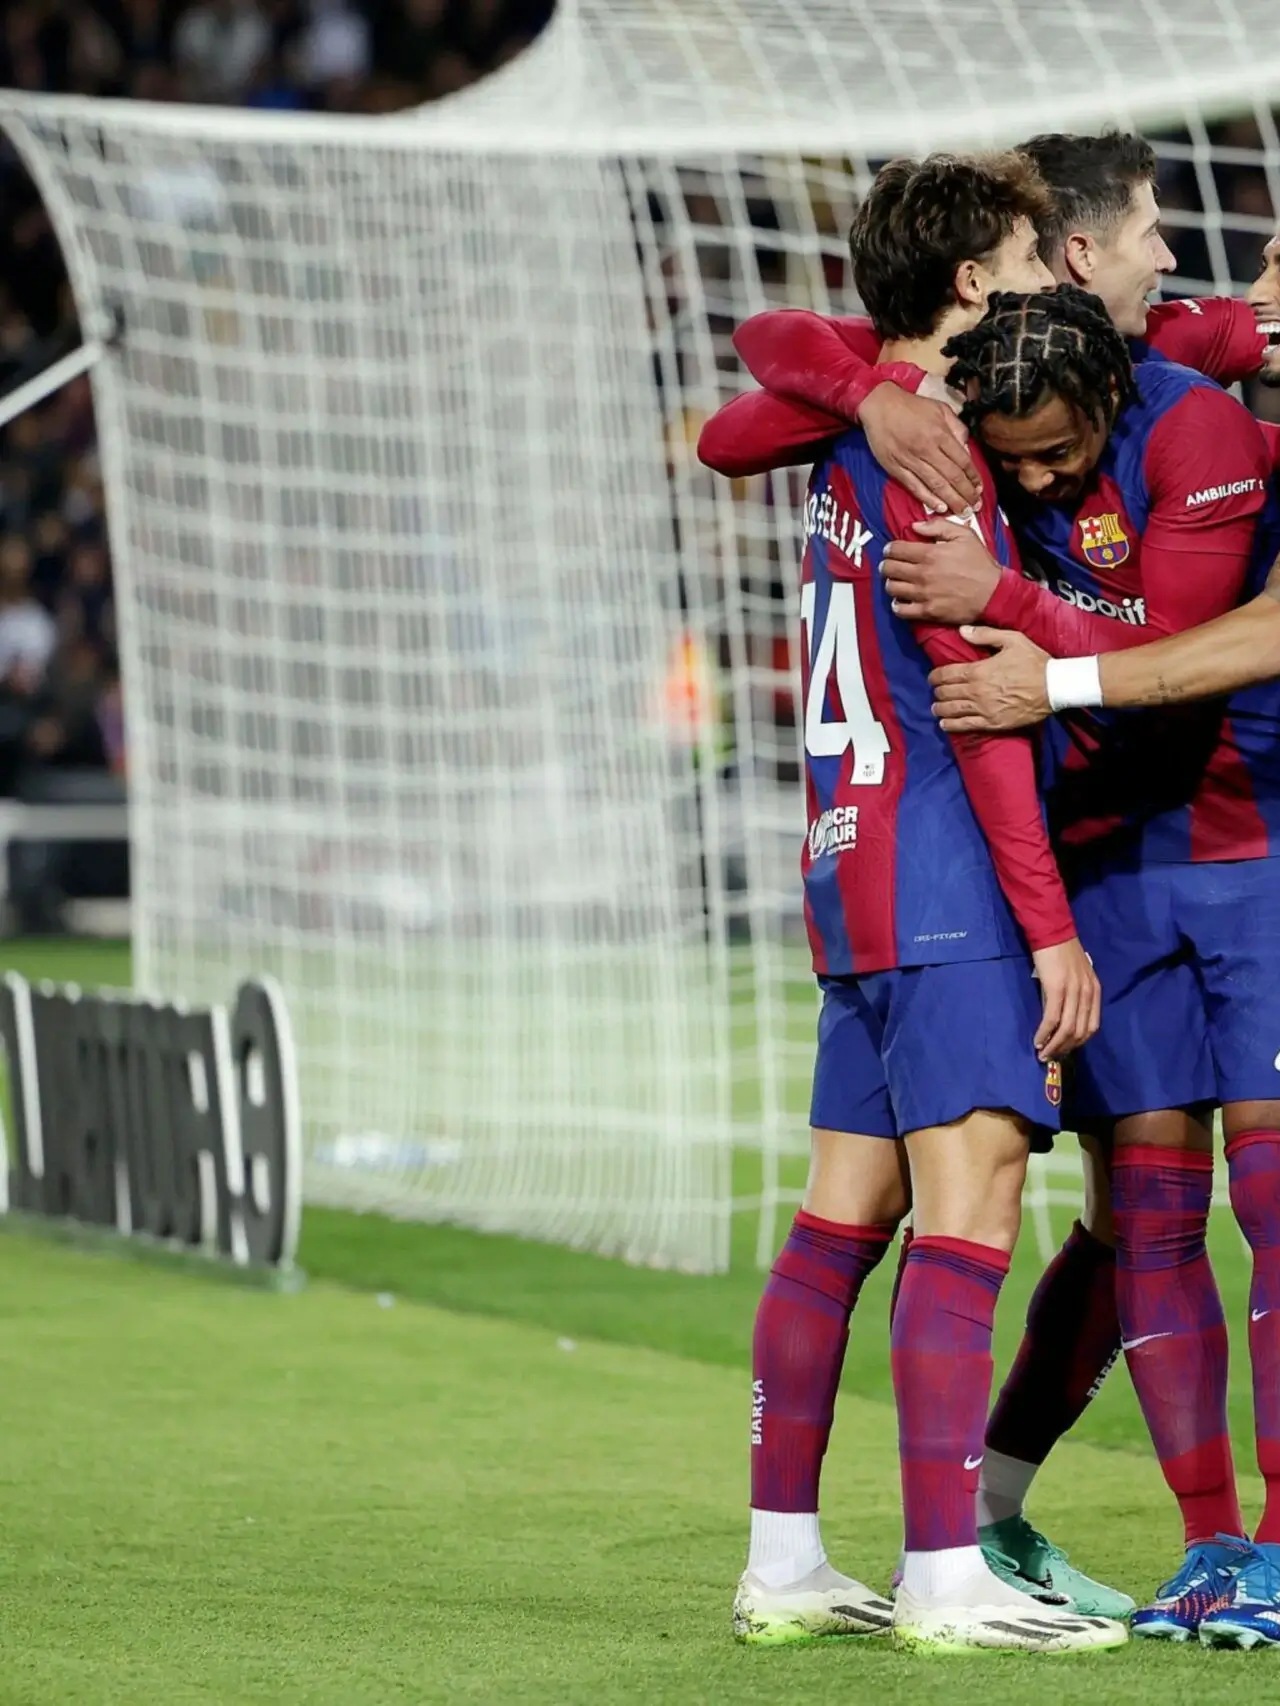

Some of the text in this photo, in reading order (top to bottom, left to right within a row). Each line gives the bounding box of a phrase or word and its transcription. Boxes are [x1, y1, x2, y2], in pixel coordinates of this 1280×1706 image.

[1186, 479, 1256, 507] AMBILIGHT
[1057, 579, 1147, 625] Spotif
[751, 1380, 767, 1445] BARÇA
